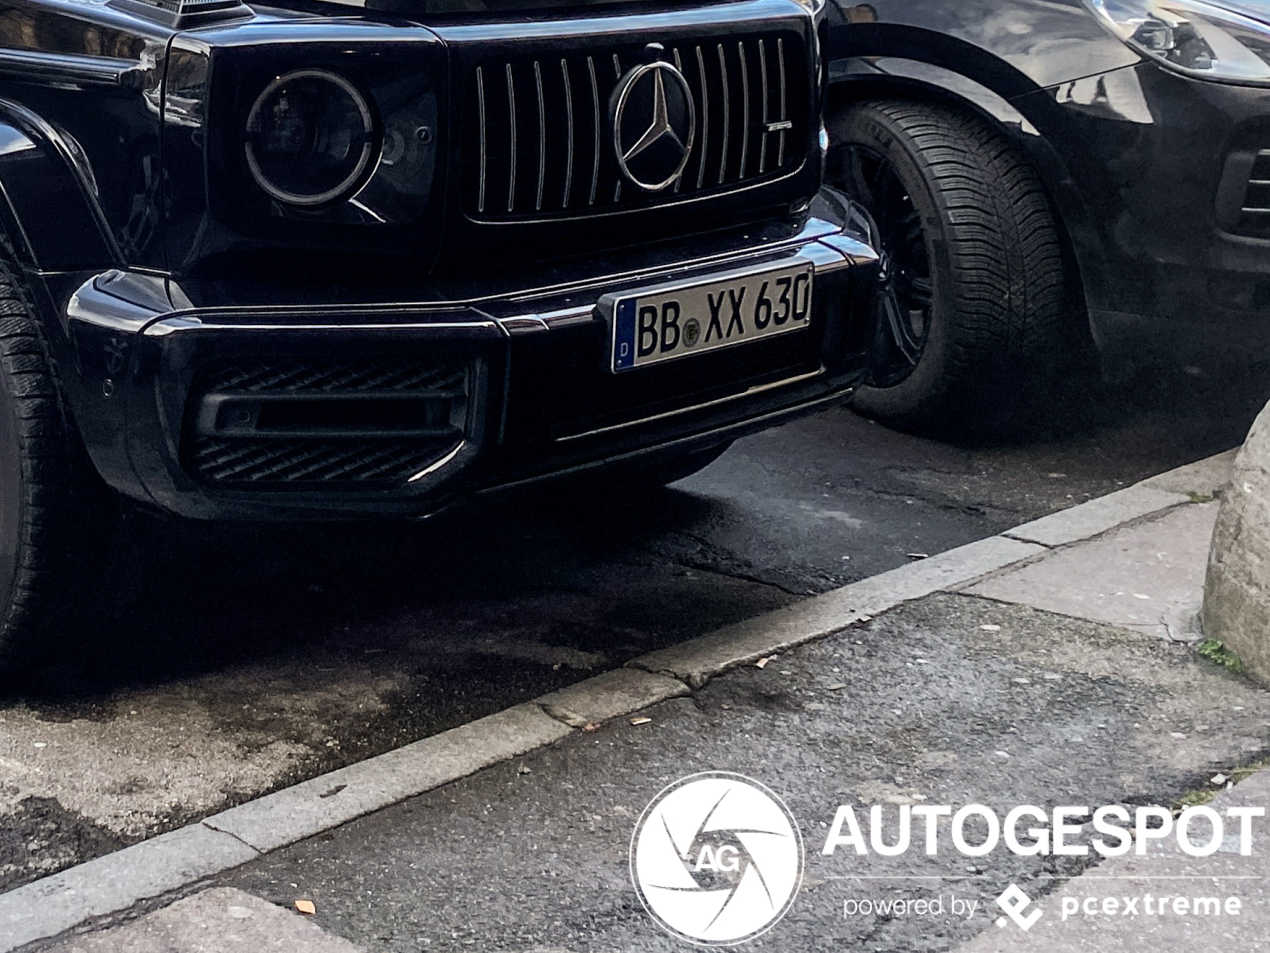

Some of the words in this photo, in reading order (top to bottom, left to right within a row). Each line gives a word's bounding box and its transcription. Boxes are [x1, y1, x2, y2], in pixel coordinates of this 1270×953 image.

[637, 300, 681, 358] BB
[704, 286, 747, 343] XX
[754, 272, 810, 330] 630
[619, 341, 629, 358] D
